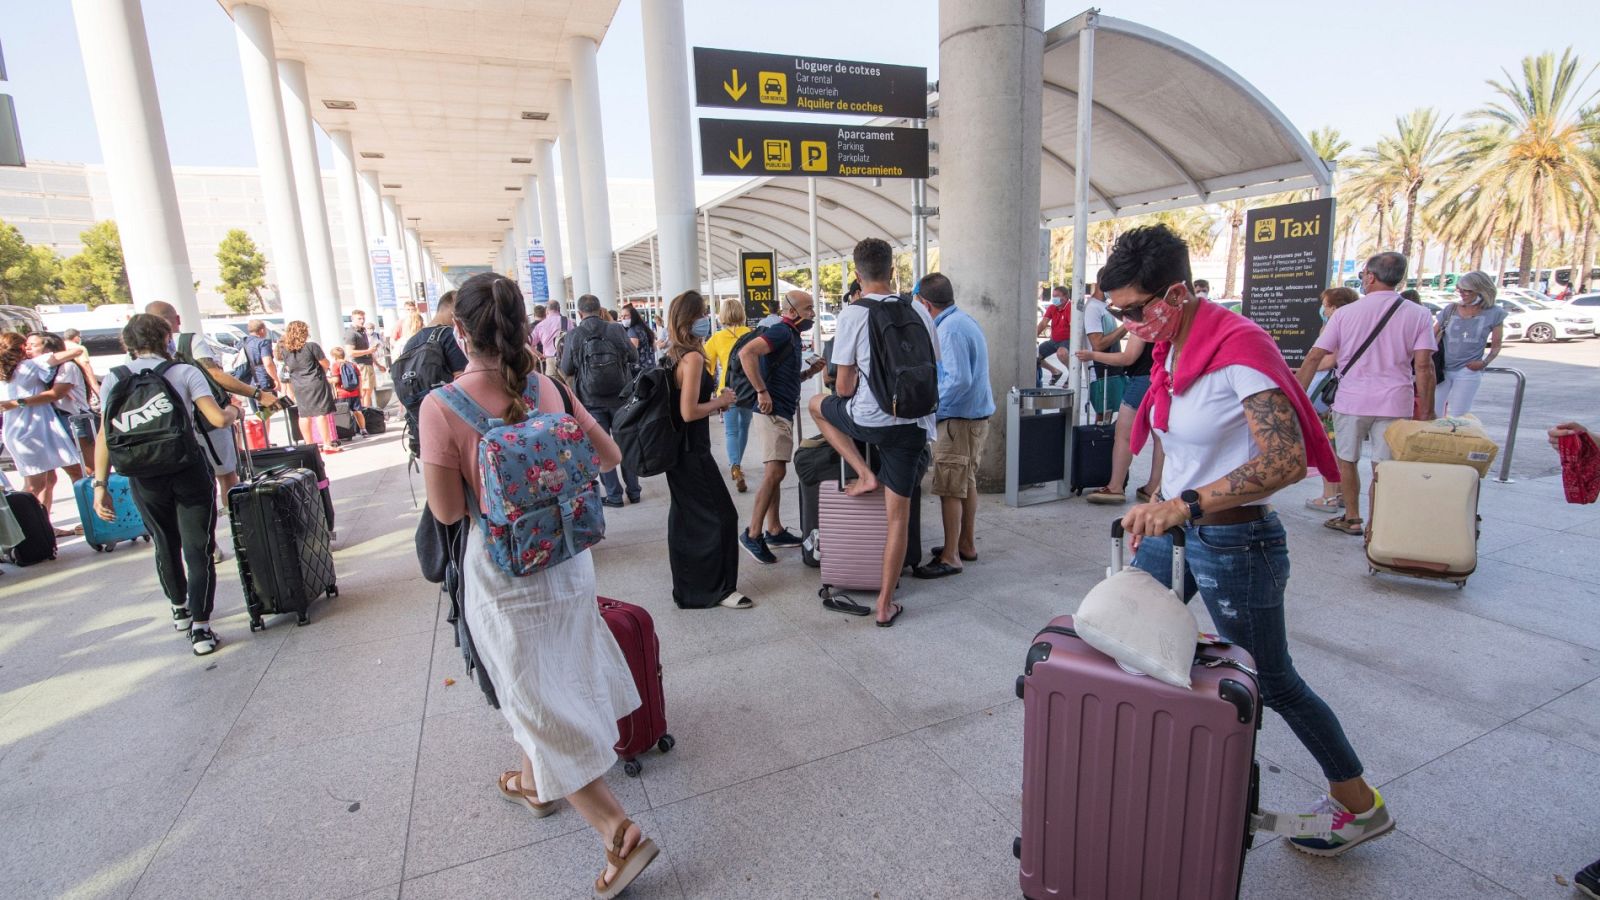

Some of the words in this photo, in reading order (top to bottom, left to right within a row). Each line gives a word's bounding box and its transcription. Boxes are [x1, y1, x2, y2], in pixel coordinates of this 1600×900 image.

[795, 58, 833, 73] Lloguer
[835, 63, 847, 73] de
[849, 65, 881, 76] cotxes
[796, 72, 809, 82] Car
[812, 74, 832, 84] rental
[796, 84, 838, 96] Autoverleih
[797, 96, 834, 110] Alquiler
[836, 100, 848, 110] de
[850, 102, 884, 112] coches
[838, 128, 895, 140] Aparcament
[838, 140, 864, 152] Parking
[808, 146, 822, 166] P
[838, 152, 870, 164] Parkplatz
[839, 164, 903, 176] Aparcamiento
[1280, 214, 1320, 238] Taxi
[747, 288, 772, 301] Taxi
[111, 392, 174, 433] VANS
